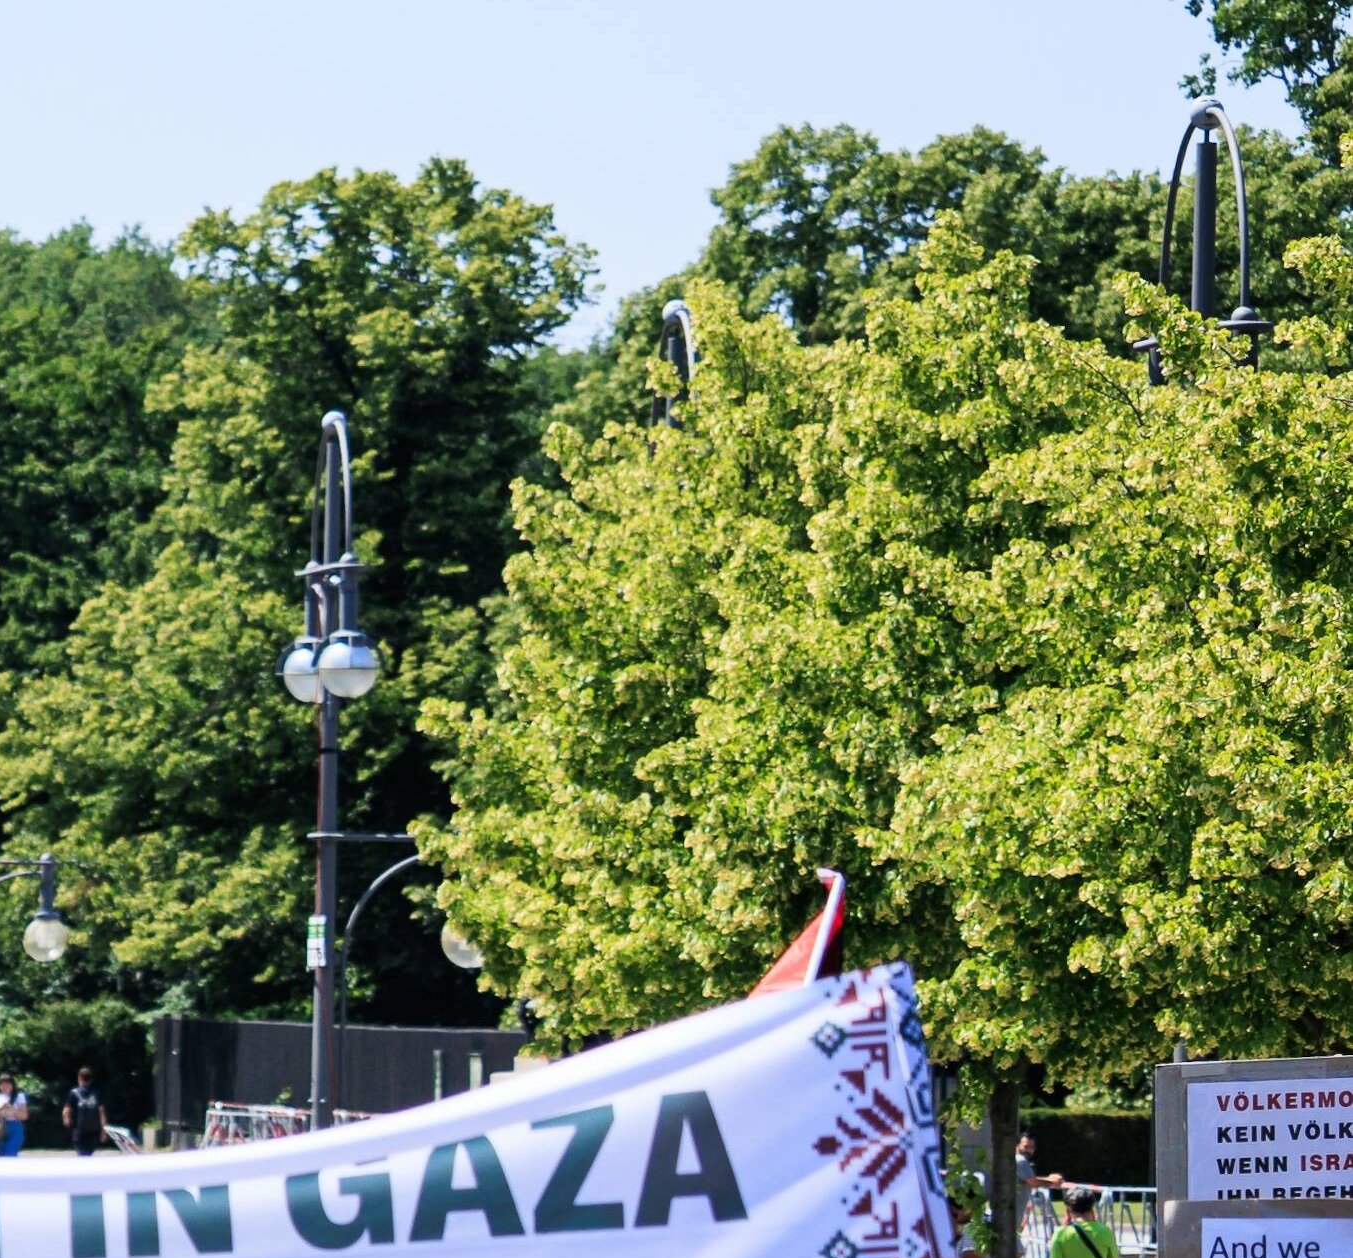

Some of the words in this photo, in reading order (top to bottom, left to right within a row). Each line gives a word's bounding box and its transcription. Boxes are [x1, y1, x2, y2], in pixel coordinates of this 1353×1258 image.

[1217, 1125, 1276, 1143] KEIN
[1288, 1120, 1353, 1140] VÖLK
[70, 1183, 234, 1258] IN
[286, 1090, 748, 1251] GAZA
[1216, 1156, 1288, 1175] WENN
